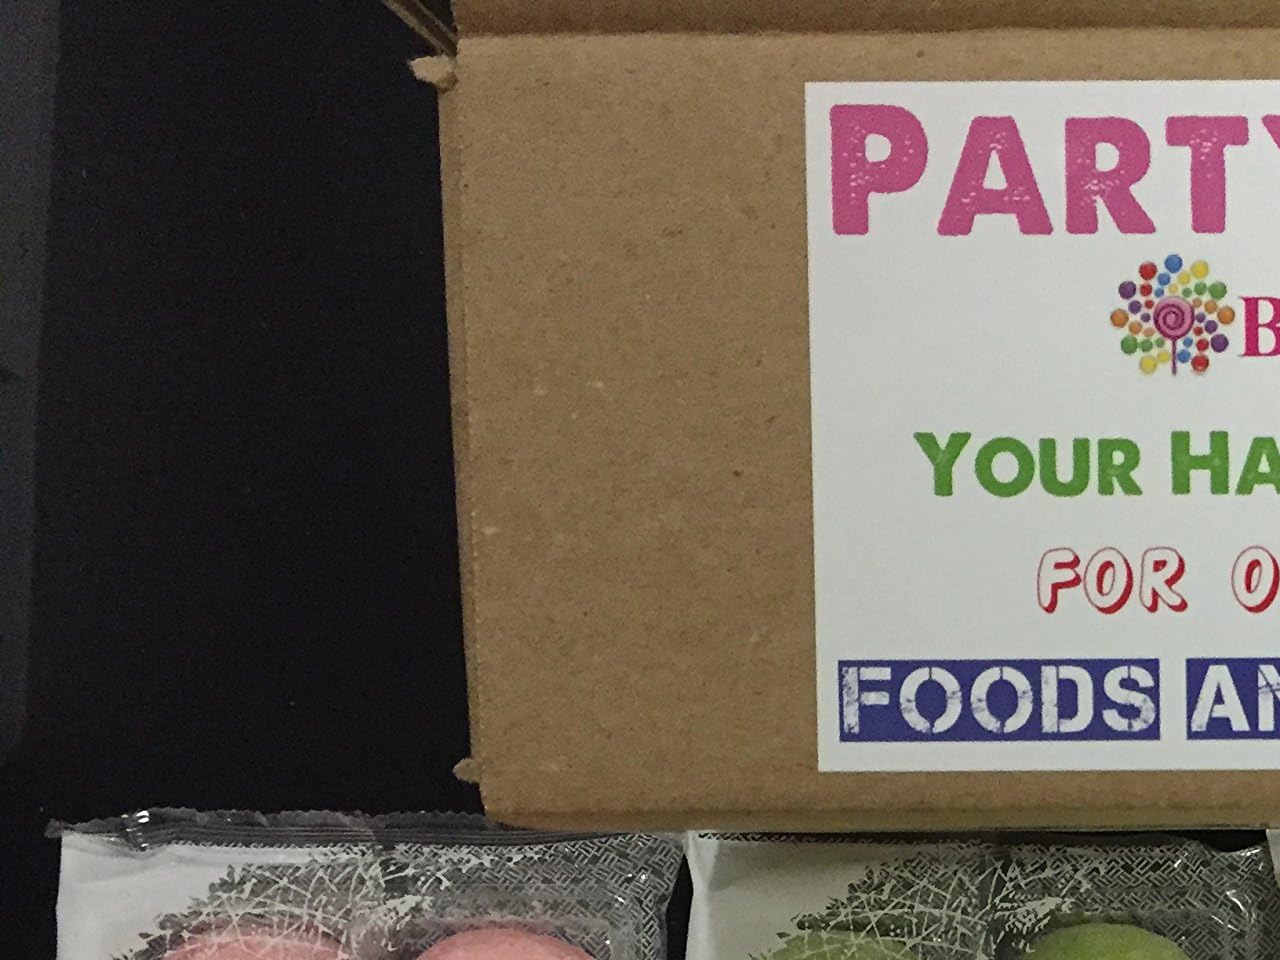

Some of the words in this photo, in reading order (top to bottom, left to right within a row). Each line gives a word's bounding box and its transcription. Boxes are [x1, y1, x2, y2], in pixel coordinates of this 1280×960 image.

[913, 431, 1142, 498] YOUR
[1036, 546, 1188, 614] FOR
[840, 661, 1157, 736] FOODS
